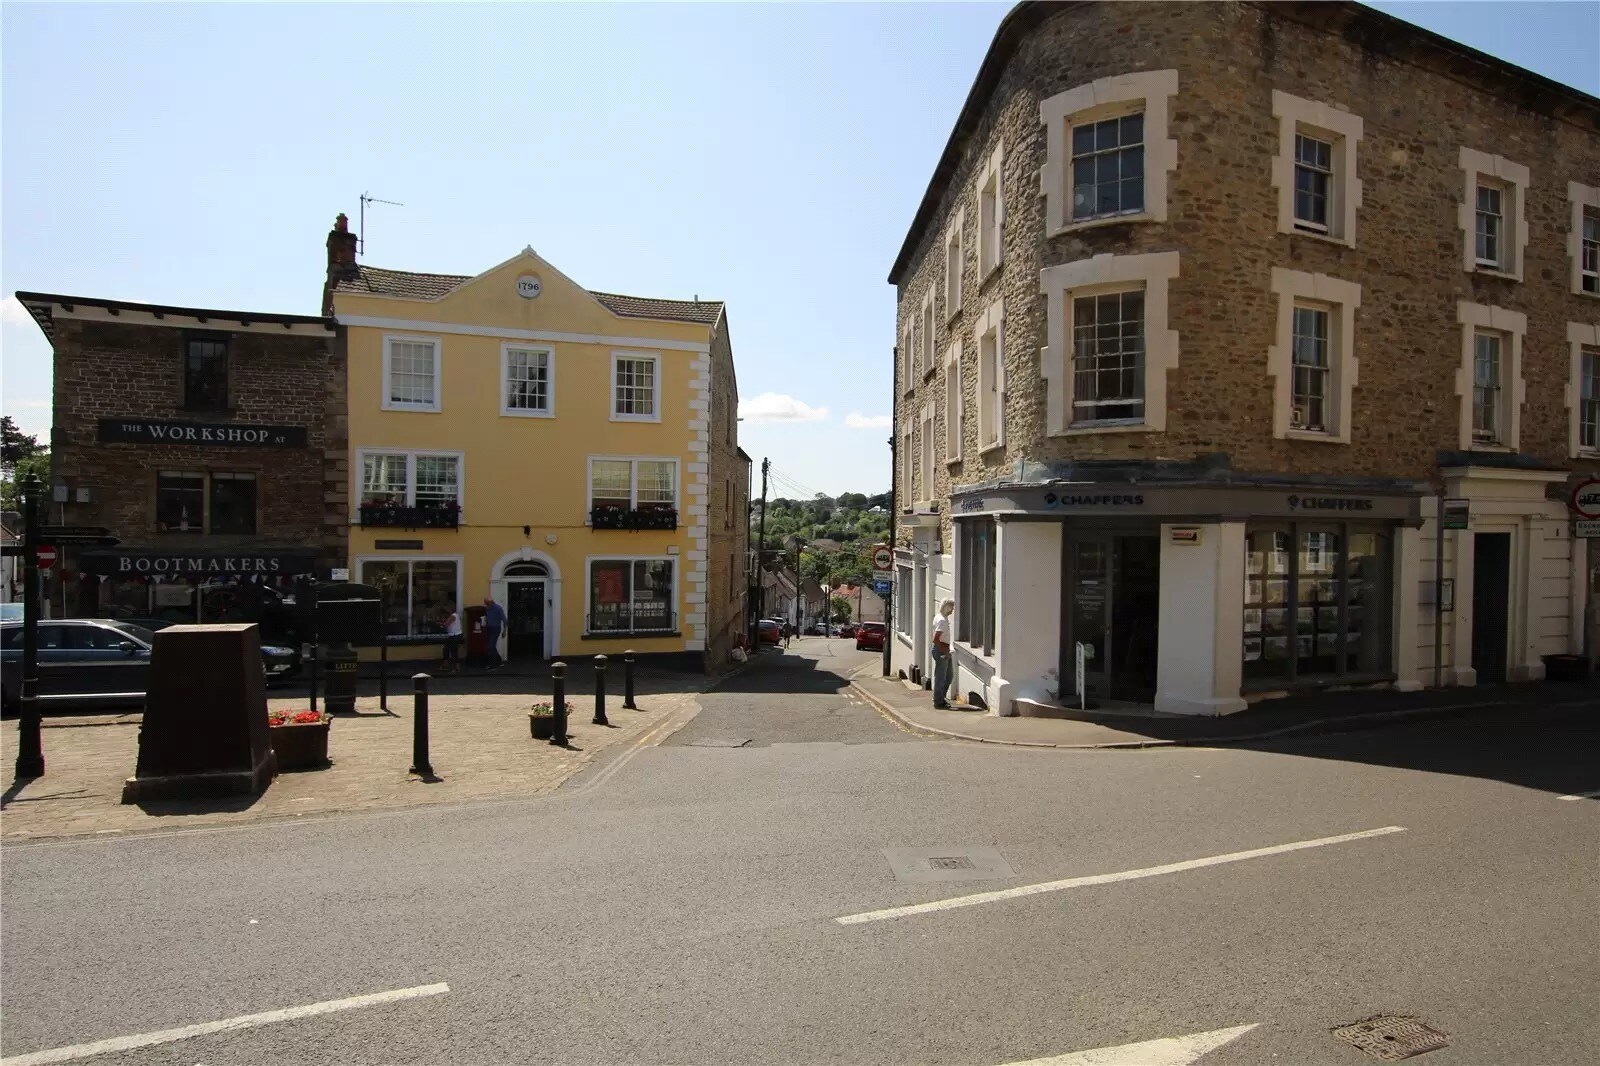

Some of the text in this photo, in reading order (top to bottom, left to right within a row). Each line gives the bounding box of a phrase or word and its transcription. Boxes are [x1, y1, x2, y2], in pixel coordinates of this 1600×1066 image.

[518, 282, 540, 291] 1796
[121, 424, 286, 444] THE WORKSHOP AT
[1061, 495, 1144, 505] CHAFFERS
[1302, 498, 1373, 510] CHAFFERS
[119, 557, 280, 571] BOOTMAKERS
